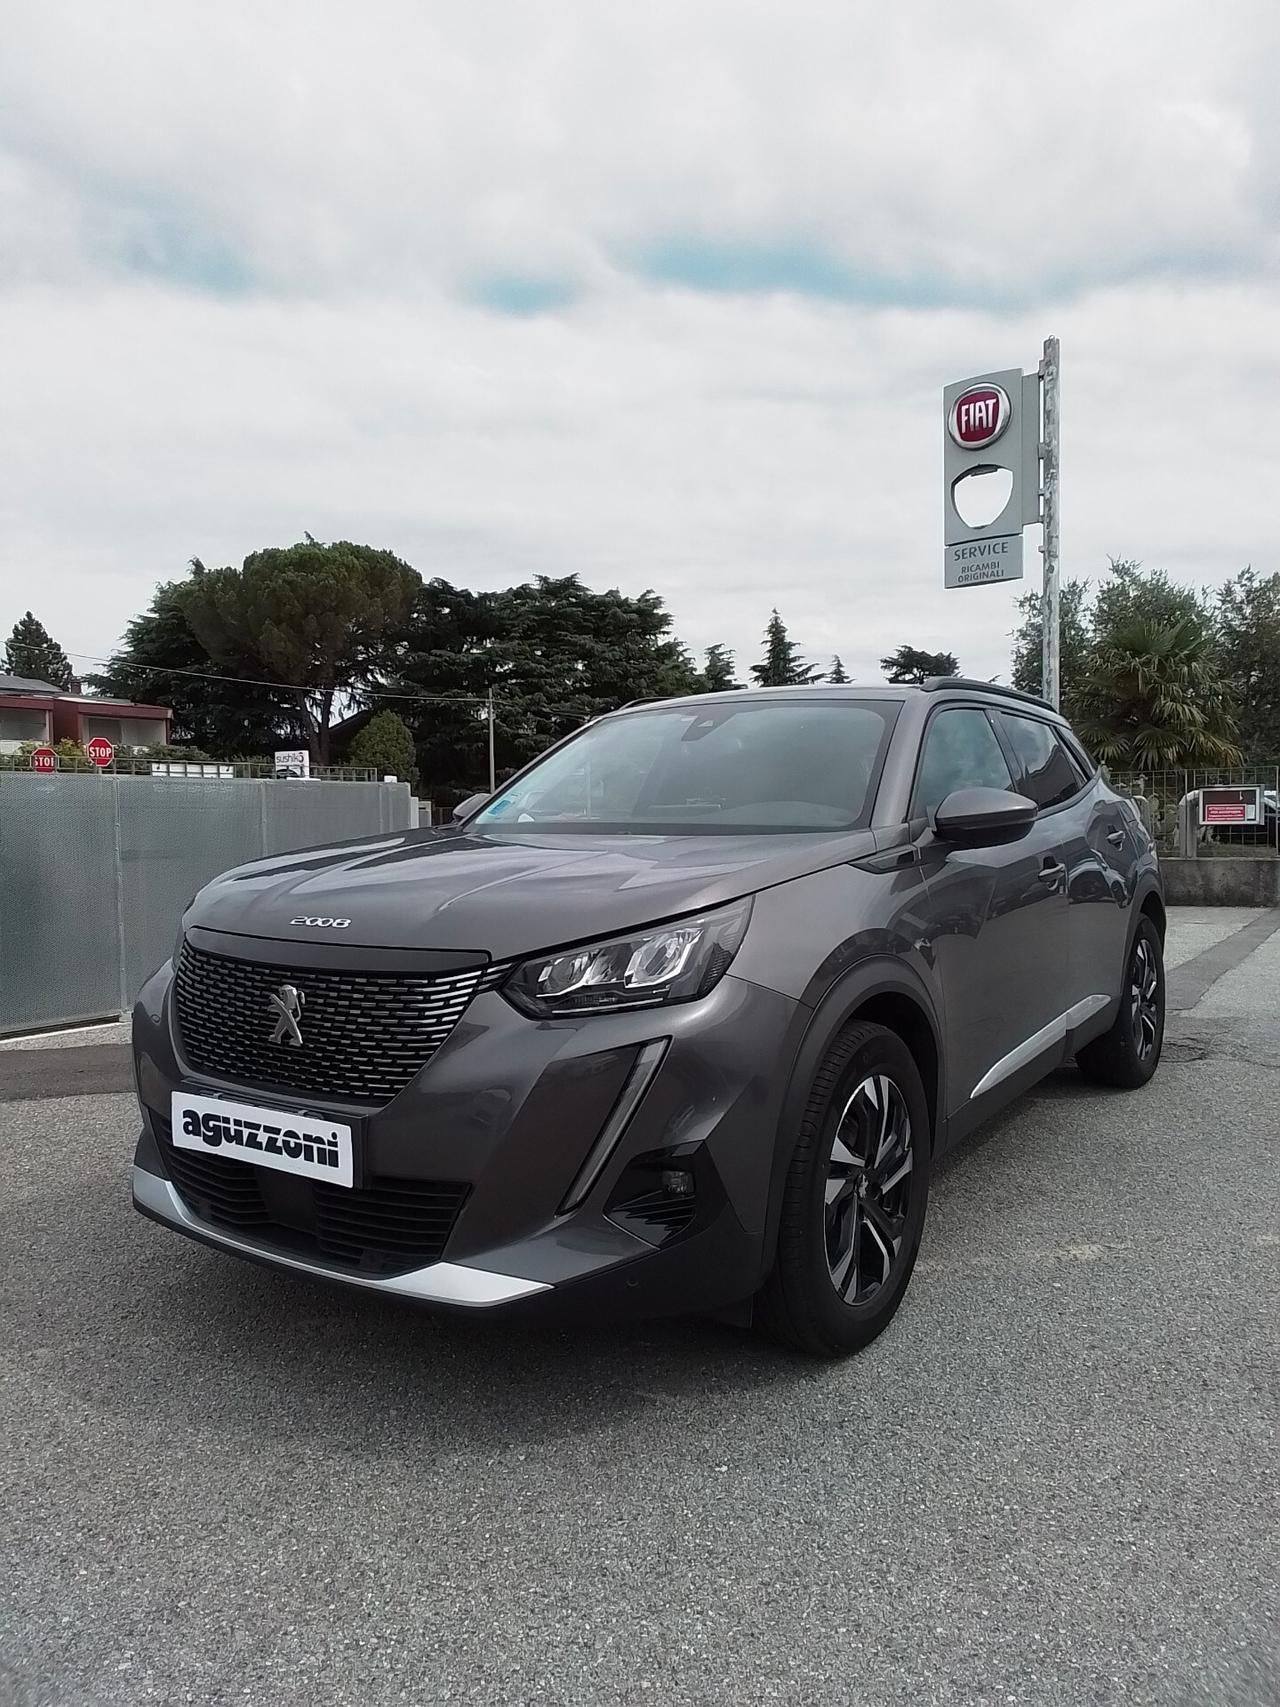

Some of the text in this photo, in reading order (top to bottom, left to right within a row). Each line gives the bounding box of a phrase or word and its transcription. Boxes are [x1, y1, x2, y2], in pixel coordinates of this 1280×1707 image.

[961, 398, 997, 434] FIAT
[954, 542, 1009, 562] SERVICE
[961, 561, 1000, 574] RICAMBI
[957, 570, 1004, 583] ORIGINALI
[89, 747, 112, 757] STOP
[289, 916, 352, 928] 2008
[182, 1108, 339, 1168] aguzzoni
